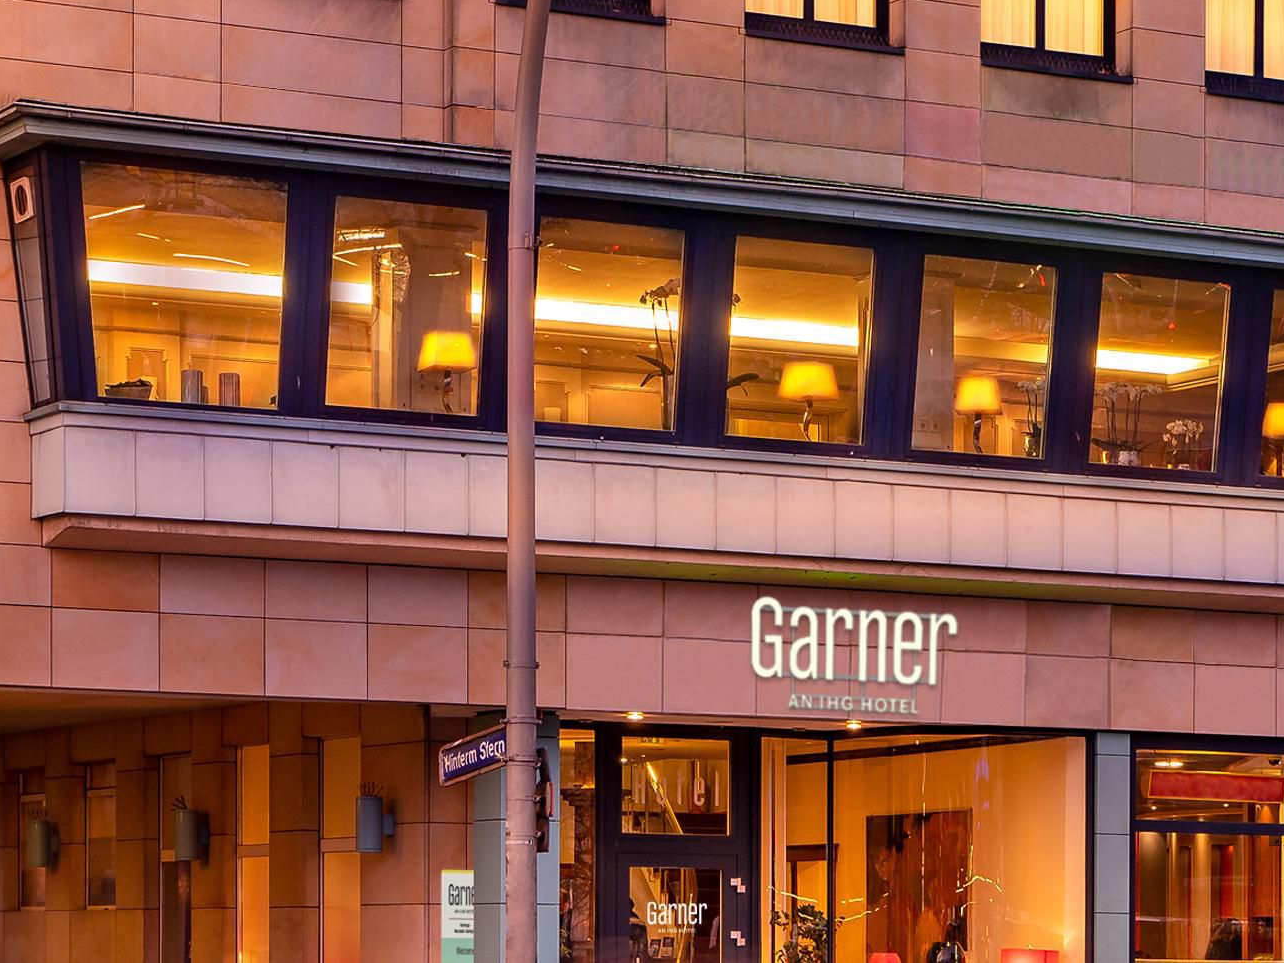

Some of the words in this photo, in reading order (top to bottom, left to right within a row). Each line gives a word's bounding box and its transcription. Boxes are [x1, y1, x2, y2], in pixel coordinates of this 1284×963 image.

[751, 596, 957, 685] Garner
[788, 694, 813, 708] AN
[820, 695, 853, 711] IHG
[861, 698, 919, 714] HOTEL
[443, 749, 477, 773] Hinterm
[479, 739, 505, 760] Stern
[646, 901, 708, 925] Garner
